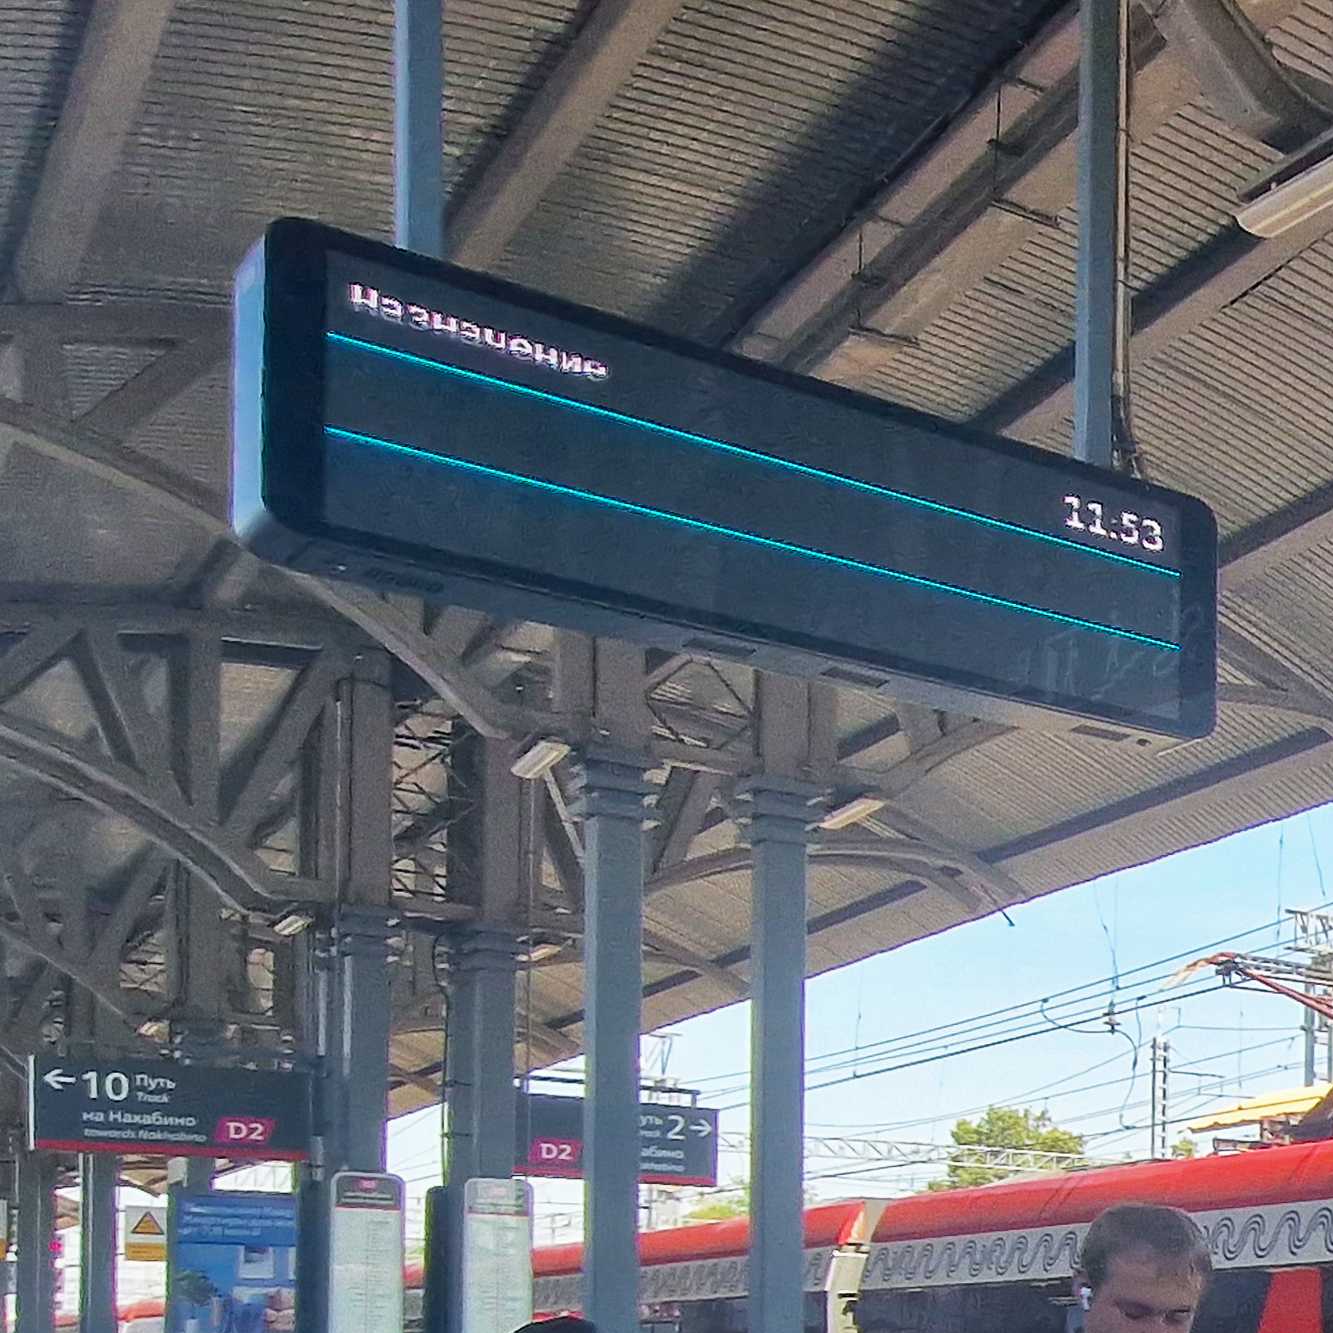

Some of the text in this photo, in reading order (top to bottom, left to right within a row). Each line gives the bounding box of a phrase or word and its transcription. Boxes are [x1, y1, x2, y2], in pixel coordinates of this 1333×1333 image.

[348, 281, 611, 381] Назначение
[1063, 495, 1164, 552] 11:53
[81, 1070, 177, 1101] 10 Путь
[82, 1109, 197, 1127] на Нахабино
[225, 1121, 266, 1141] D2
[667, 1114, 686, 1140] 2
[538, 1142, 575, 1161] D2
